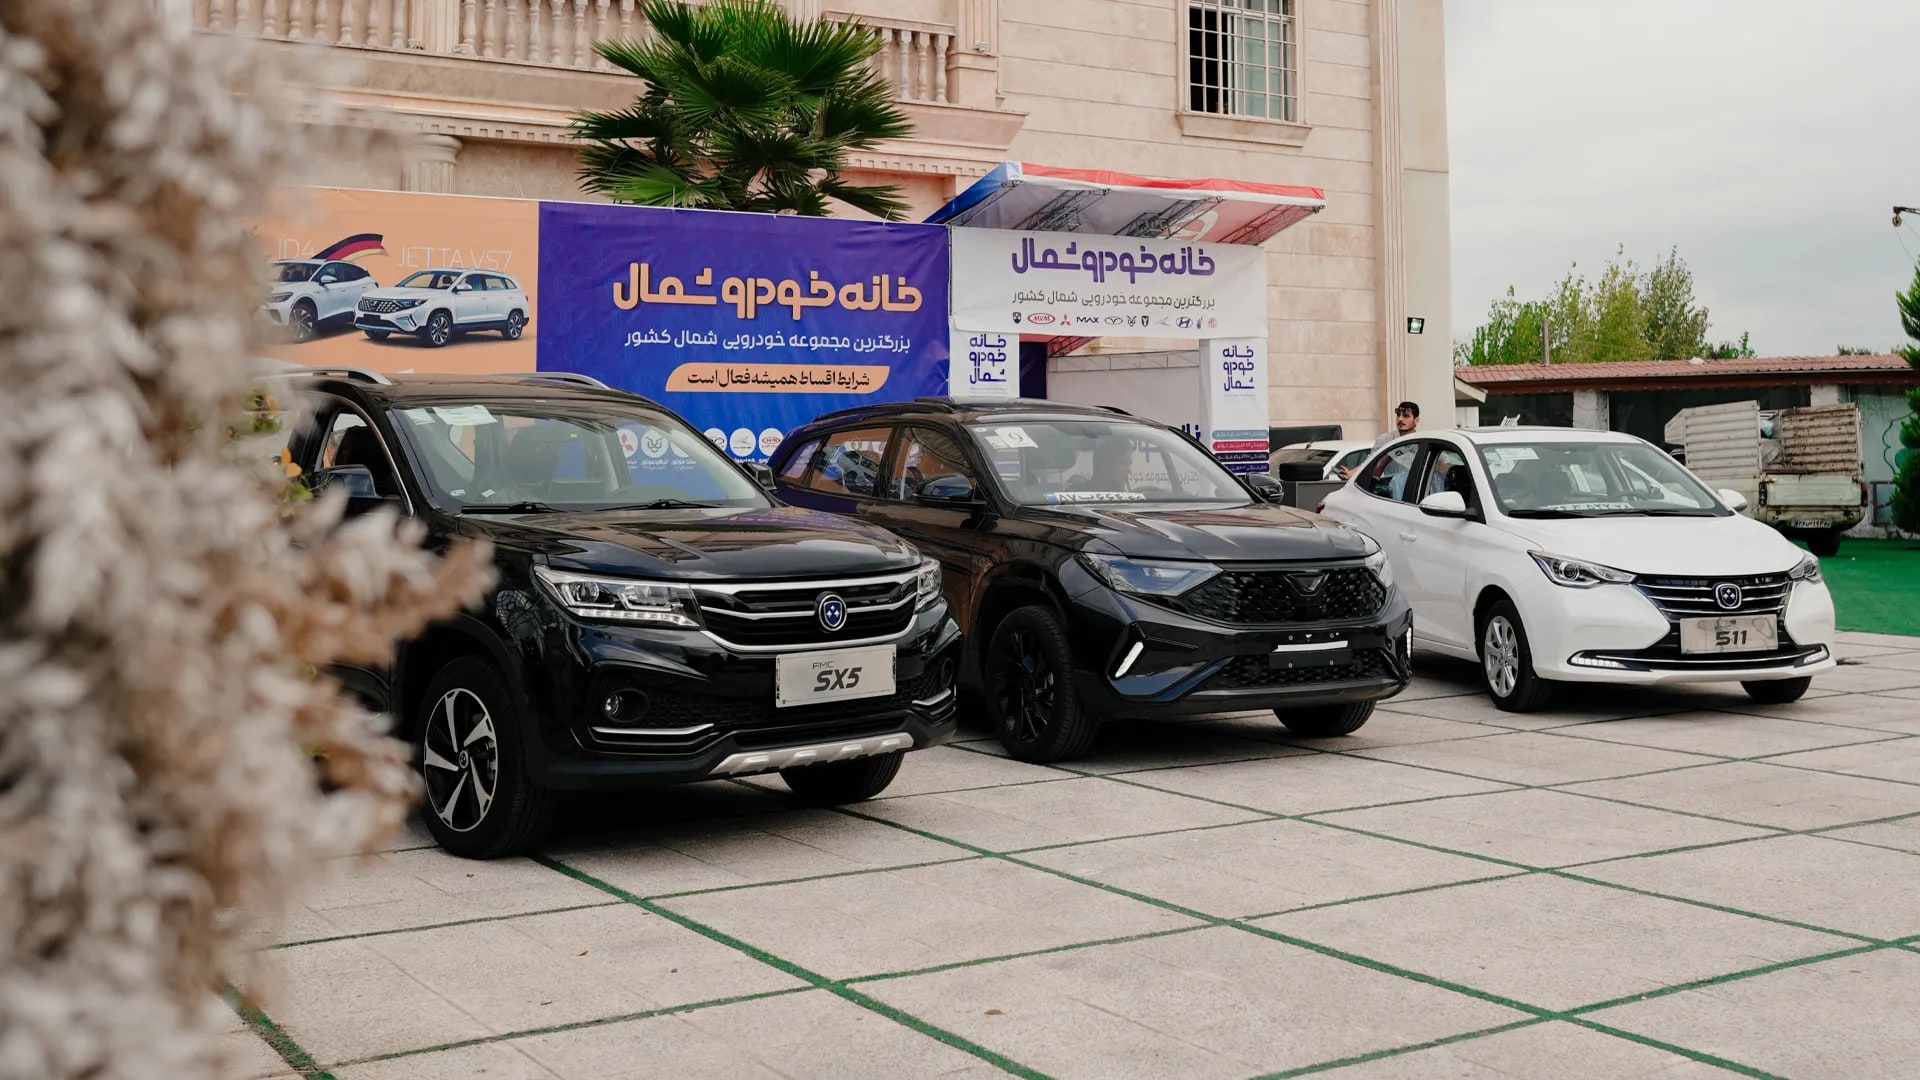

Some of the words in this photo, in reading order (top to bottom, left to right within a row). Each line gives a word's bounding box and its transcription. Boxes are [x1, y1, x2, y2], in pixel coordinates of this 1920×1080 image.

[396, 246, 464, 268] JETTA
[469, 250, 513, 271] VS7
[1011, 237, 1081, 274] شمال
[1158, 246, 1215, 276] خانه
[1081, 245, 1157, 284] خودرو
[612, 262, 718, 310] شمال
[838, 273, 923, 312] خانه
[721, 270, 836, 321] خودرو
[1012, 289, 1045, 304] کشور
[1047, 291, 1078, 304] شمال
[1081, 291, 1126, 306] خودرویی
[1128, 293, 1172, 309] مجموعه
[1076, 316, 1099, 324] MAX
[624, 329, 671, 347] کشور
[673, 330, 718, 346] شمال
[722, 331, 785, 350] خودرویی
[788, 332, 850, 352] مجموعه
[852, 334, 911, 353] بزرگترین
[969, 333, 1007, 348] خانه
[969, 349, 1007, 367] خودرو
[1222, 345, 1254, 358] خانه
[969, 367, 1007, 384] شمال
[1223, 359, 1255, 375] خودرو
[687, 369, 718, 384] است
[725, 369, 751, 387] فعال
[752, 372, 798, 388] همیشه
[799, 370, 836, 386] اقساط
[837, 369, 870, 389] شرایط
[1223, 377, 1255, 391] شمال
[1715, 630, 1748, 645] 511
[812, 660, 834, 669] FMC
[813, 667, 862, 692] SX5
